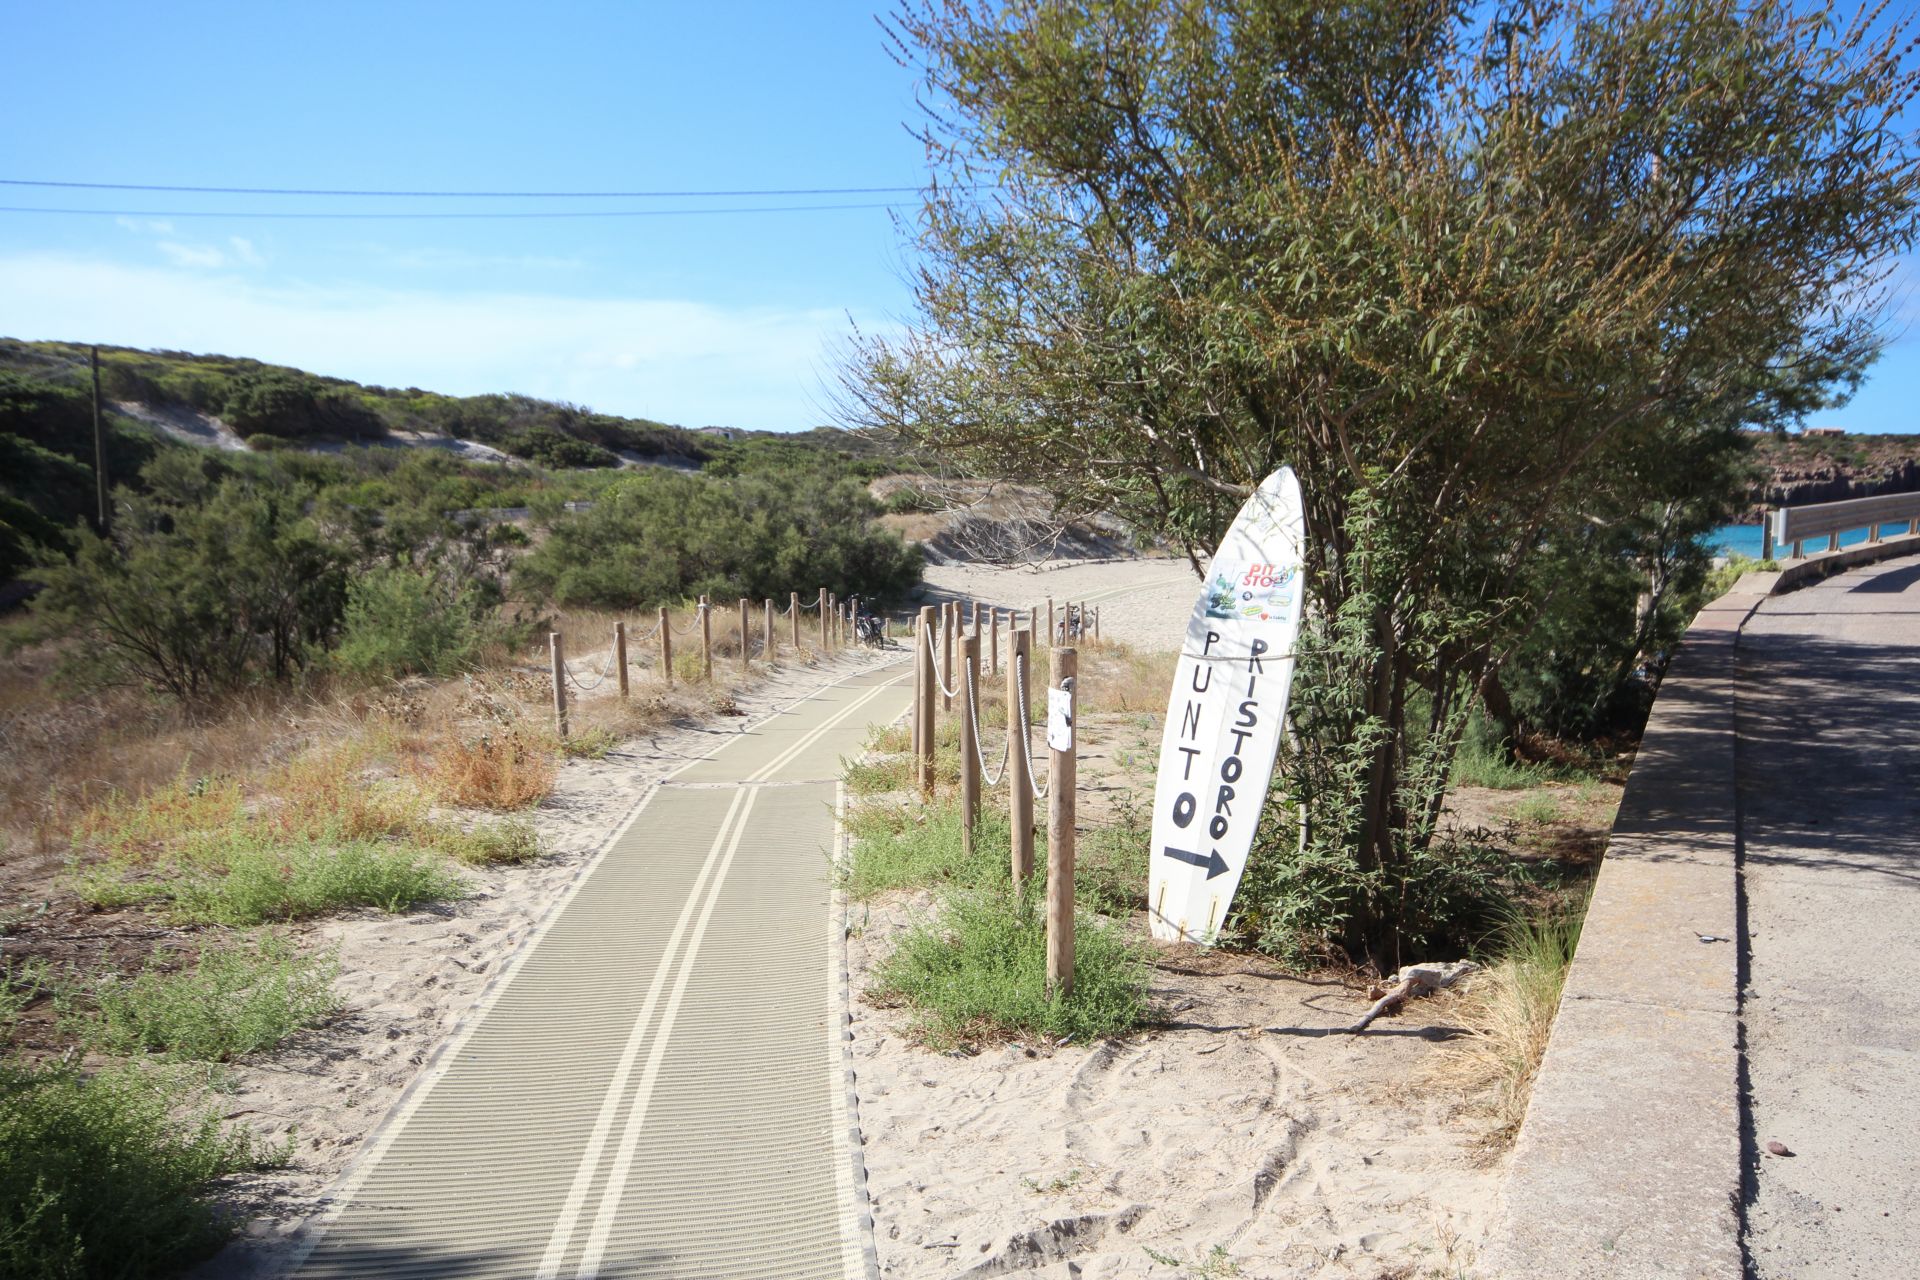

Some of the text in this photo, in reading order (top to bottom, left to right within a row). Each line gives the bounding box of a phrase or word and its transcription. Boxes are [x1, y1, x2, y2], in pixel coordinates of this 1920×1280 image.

[1242, 575, 1279, 588] STO
[1249, 563, 1274, 577] PIT
[1172, 631, 1220, 829] PUNTO
[1209, 638, 1269, 841] RISTORO
